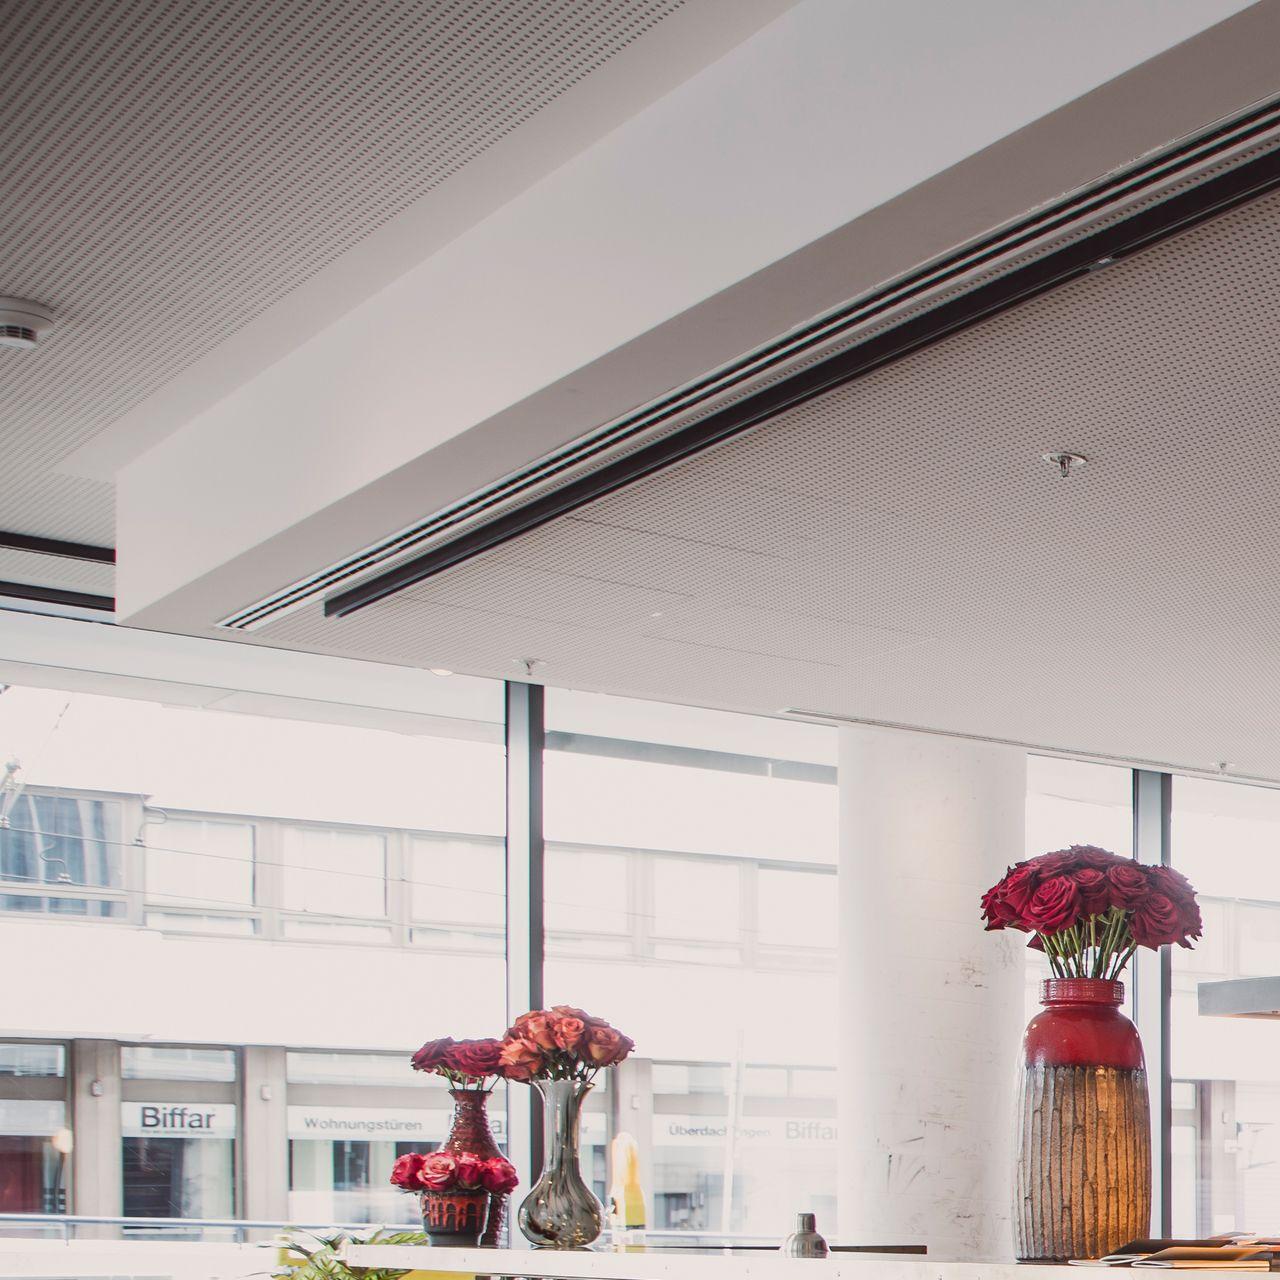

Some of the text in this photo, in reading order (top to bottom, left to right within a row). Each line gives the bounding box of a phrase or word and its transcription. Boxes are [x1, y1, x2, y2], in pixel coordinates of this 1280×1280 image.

[141, 1106, 216, 1129] Biffar
[303, 1116, 424, 1133] Wohnungstüren
[668, 1122, 771, 1139] Überdacngen
